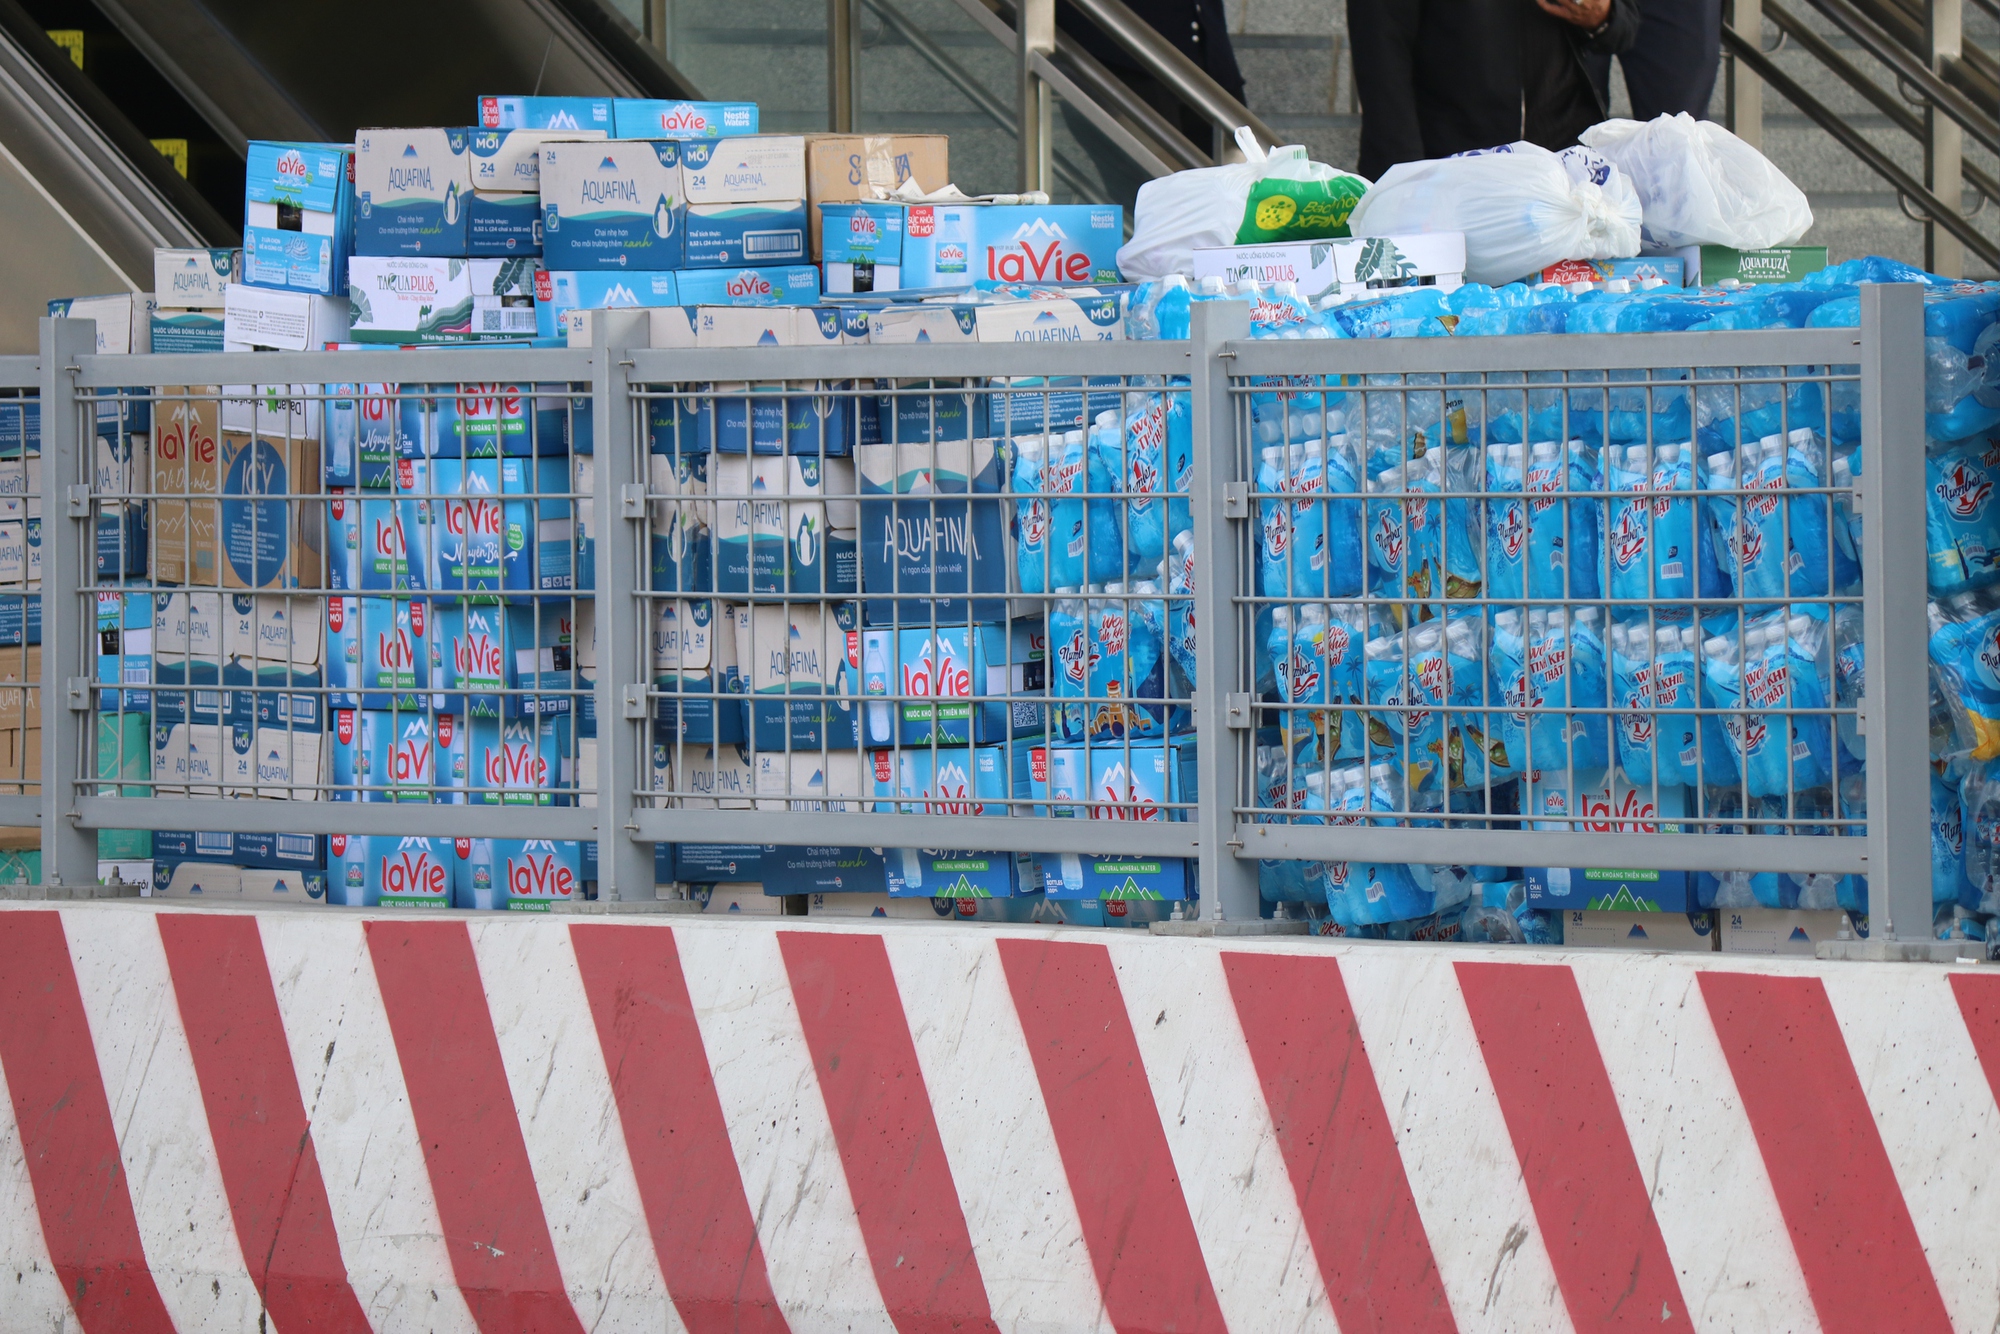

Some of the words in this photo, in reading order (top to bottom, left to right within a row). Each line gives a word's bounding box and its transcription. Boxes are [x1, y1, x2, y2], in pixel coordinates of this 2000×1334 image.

[724, 107, 750, 120] Nestlé
[661, 110, 705, 130] laVie
[724, 119, 750, 127] Waters
[362, 139, 370, 148] 24
[547, 151, 556, 161] 24
[277, 157, 306, 176] laVie
[480, 163, 495, 173] 24
[388, 166, 432, 192] AQUAFINA
[692, 176, 706, 186] 24
[723, 172, 763, 187] AQUAFINA
[581, 179, 637, 204] AQUAFINA
[397, 215, 407, 223] Chai
[850, 215, 876, 233] laVie
[1090, 214, 1115, 223] Nestlé
[594, 228, 606, 236] Chai
[606, 228, 617, 238] nhẹ
[908, 223, 920, 234] TỐT
[920, 223, 935, 234] HƠN
[571, 240, 581, 248] Cho
[581, 239, 592, 248] môi
[610, 239, 622, 247] thêm
[623, 231, 653, 248] xanh
[939, 249, 963, 258] laVie
[987, 240, 1092, 282] laVie
[1738, 255, 1791, 273] AQUAPLUZA
[787, 273, 813, 282] Nestlé
[1097, 269, 1116, 278] 100%
[173, 271, 210, 292] AQUAFINA
[377, 272, 435, 292] TAQUAPLUS
[651, 280, 668, 288] Nestlé
[726, 277, 771, 297] laVie
[788, 281, 814, 289] Waters
[573, 316, 583, 327] 24
[703, 315, 713, 326] 24
[939, 401, 963, 419] xanh
[157, 423, 215, 464] laVie
[1936, 471, 1984, 502] Number
[883, 512, 980, 563] AQUAFINA
[949, 562, 963, 573] khiết
[157, 616, 166, 627] 24
[740, 613, 748, 624] 24
[240, 619, 249, 630] 24
[695, 634, 704, 644] 24
[903, 656, 971, 696] laVie
[868, 680, 885, 691] laVie
[905, 707, 921, 718] NƯỚC
[156, 755, 166, 765] 24
[238, 760, 248, 771] 24
[761, 757, 770, 768] 24
[874, 761, 890, 770] BETTER
[980, 764, 994, 772] Waters
[654, 775, 664, 786] 24
[875, 771, 891, 780] HEALTH
[1546, 796, 1565, 807] laVie
[332, 835, 345, 847] MỚI
[456, 837, 469, 849] MỚI
[806, 847, 819, 856] Chai
[822, 859, 836, 868] thêm
[837, 850, 868, 868] xanh
[347, 868, 363, 879] laVie
[381, 852, 446, 893] laVie
[473, 871, 490, 881] laVie
[507, 853, 573, 895] laVie
[1585, 869, 1601, 878] NƯỚC
[1601, 870, 1623, 879] KHOÁNG
[1624, 871, 1641, 879] THIÊN
[1641, 871, 1657, 880] NHIÊN
[1046, 878, 1063, 886] BOTTLES
[813, 894, 823, 905] 24
[509, 900, 523, 910] NƯỚC
[524, 901, 544, 911] KHOÁNG
[1572, 912, 1583, 922] 24
[1731, 915, 1742, 925] 24
